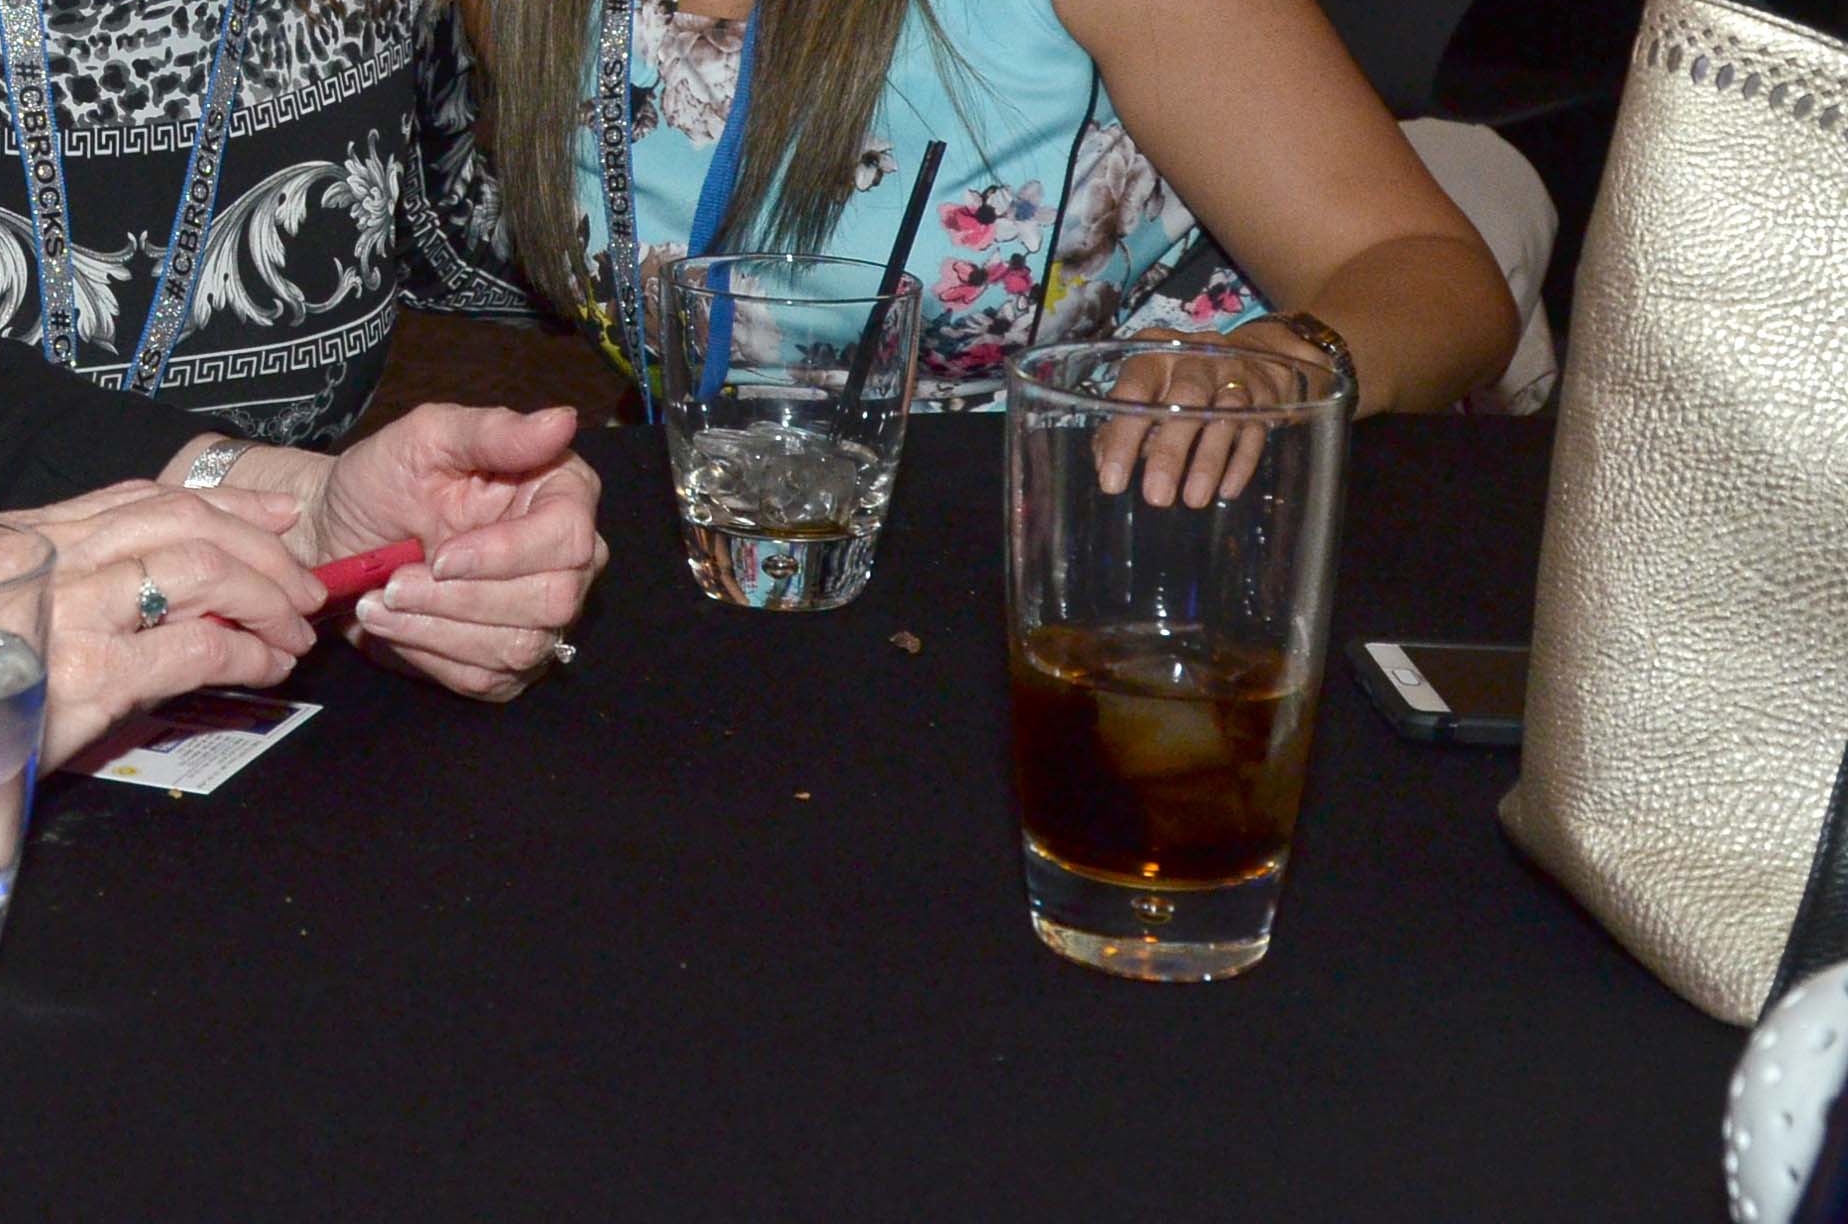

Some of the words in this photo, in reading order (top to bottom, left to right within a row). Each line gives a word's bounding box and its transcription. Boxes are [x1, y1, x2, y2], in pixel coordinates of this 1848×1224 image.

[15, 61, 65, 257] #CBROCKS
[166, 109, 224, 300] #CBROCKS
[603, 60, 632, 238] #CBROCKS
